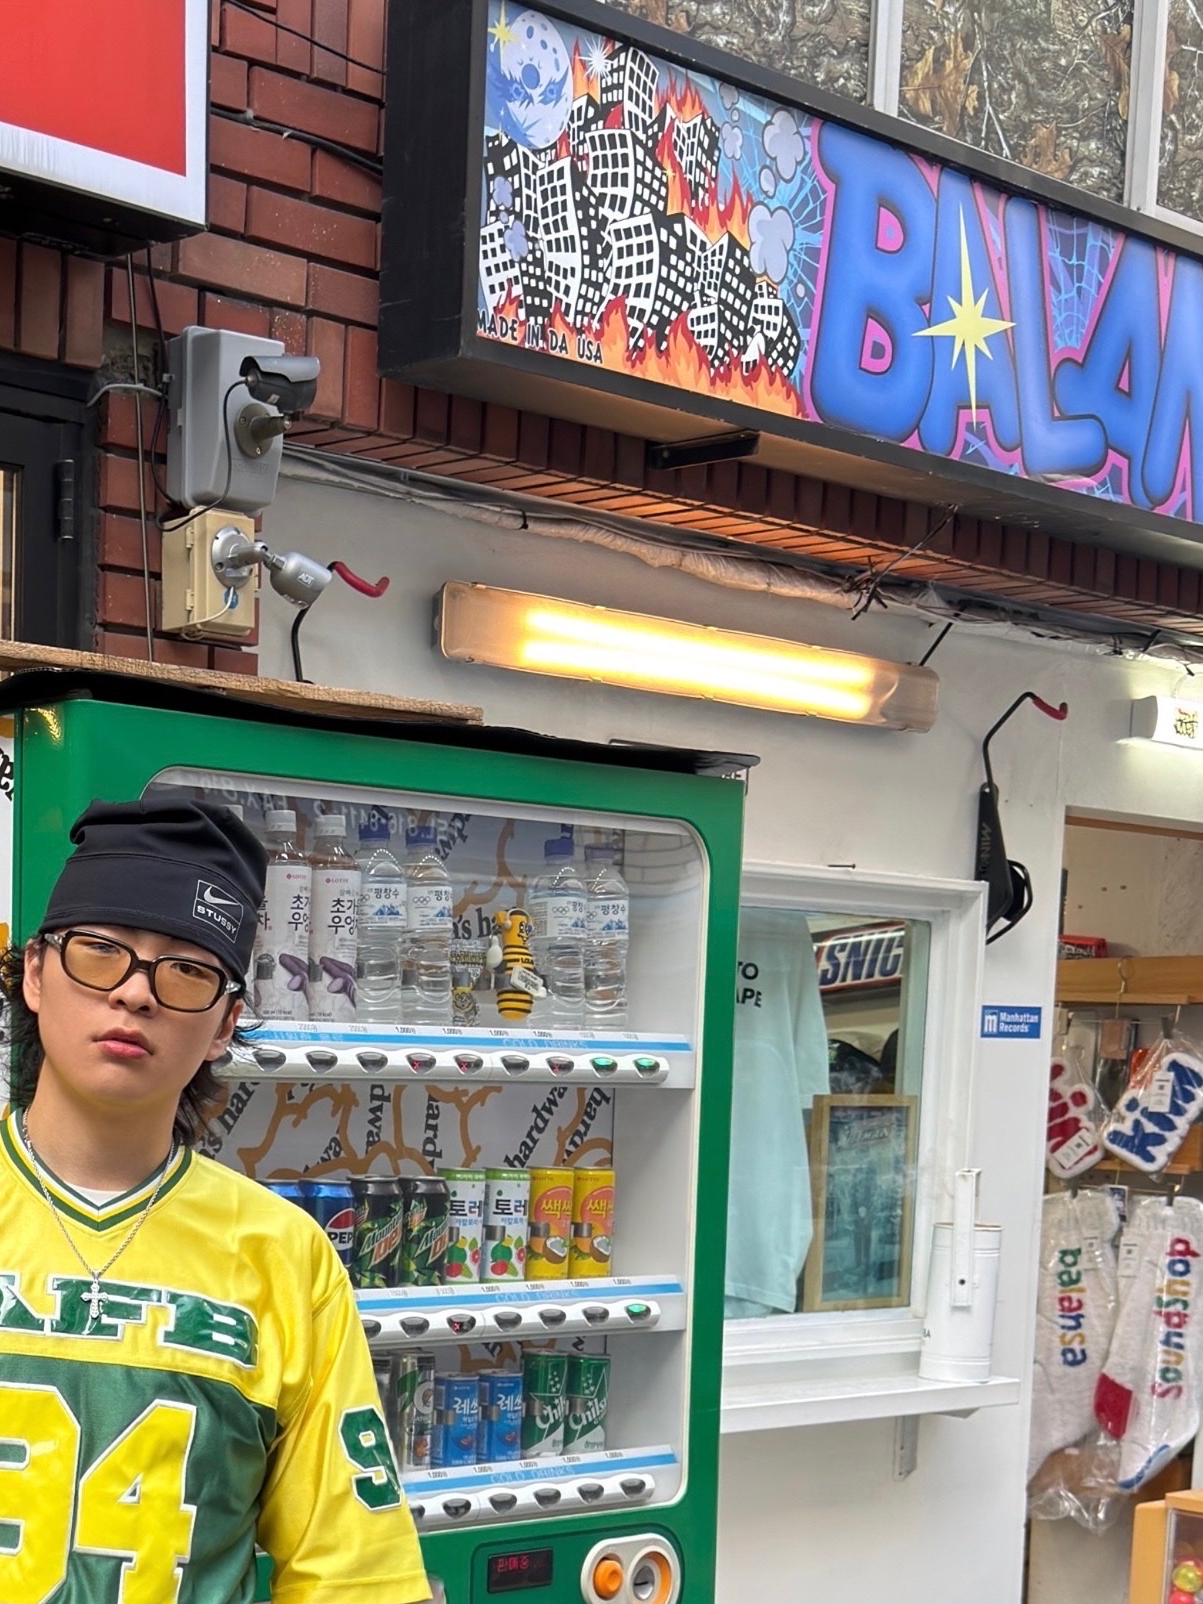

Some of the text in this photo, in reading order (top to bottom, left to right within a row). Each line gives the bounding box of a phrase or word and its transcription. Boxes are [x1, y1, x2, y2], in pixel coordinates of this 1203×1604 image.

[476, 309, 518, 342] MADE
[548, 328, 569, 356] DA
[577, 335, 604, 365] USA
[373, 887, 400, 900] 평창수
[196, 904, 238, 936] STUSSY
[999, 1011, 1039, 1024] Manhattan
[999, 1022, 1029, 1034] Records
[1056, 1246, 1089, 1368] balansa
[336, 1404, 403, 1513] 9
